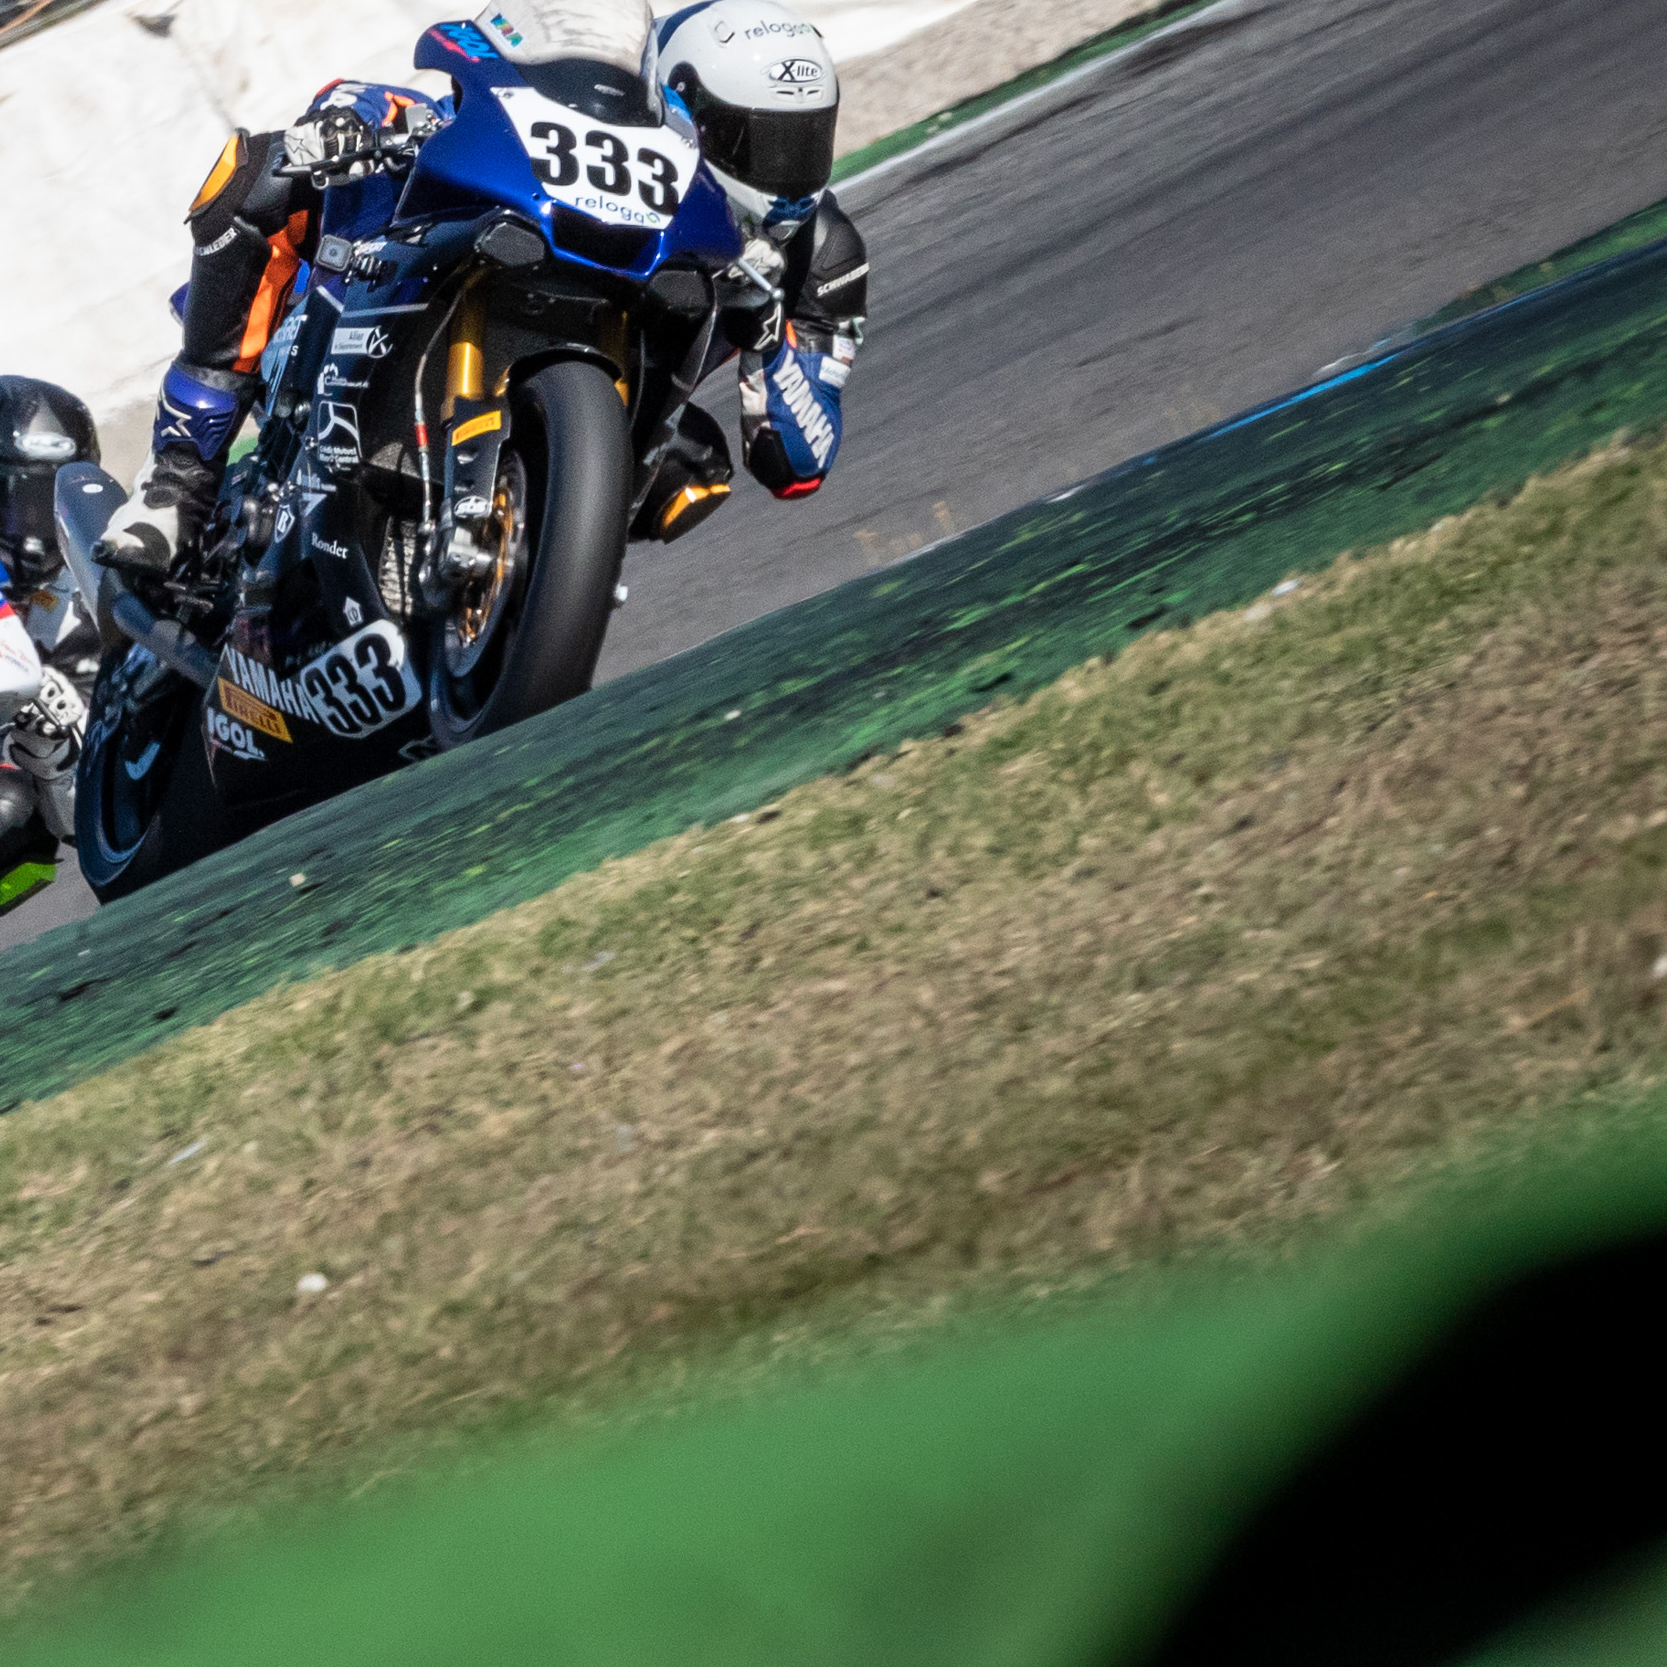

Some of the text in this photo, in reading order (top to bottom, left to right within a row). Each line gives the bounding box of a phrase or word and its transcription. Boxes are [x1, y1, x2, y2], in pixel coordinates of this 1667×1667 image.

[777, 61, 818, 81] X-lite
[529, 121, 679, 216] 333
[773, 348, 835, 469] YAMAHA
[311, 532, 349, 560] Rondet
[224, 642, 321, 725] YAMAHA
[224, 686, 281, 734] PIRELLI
[303, 633, 407, 735] 333
